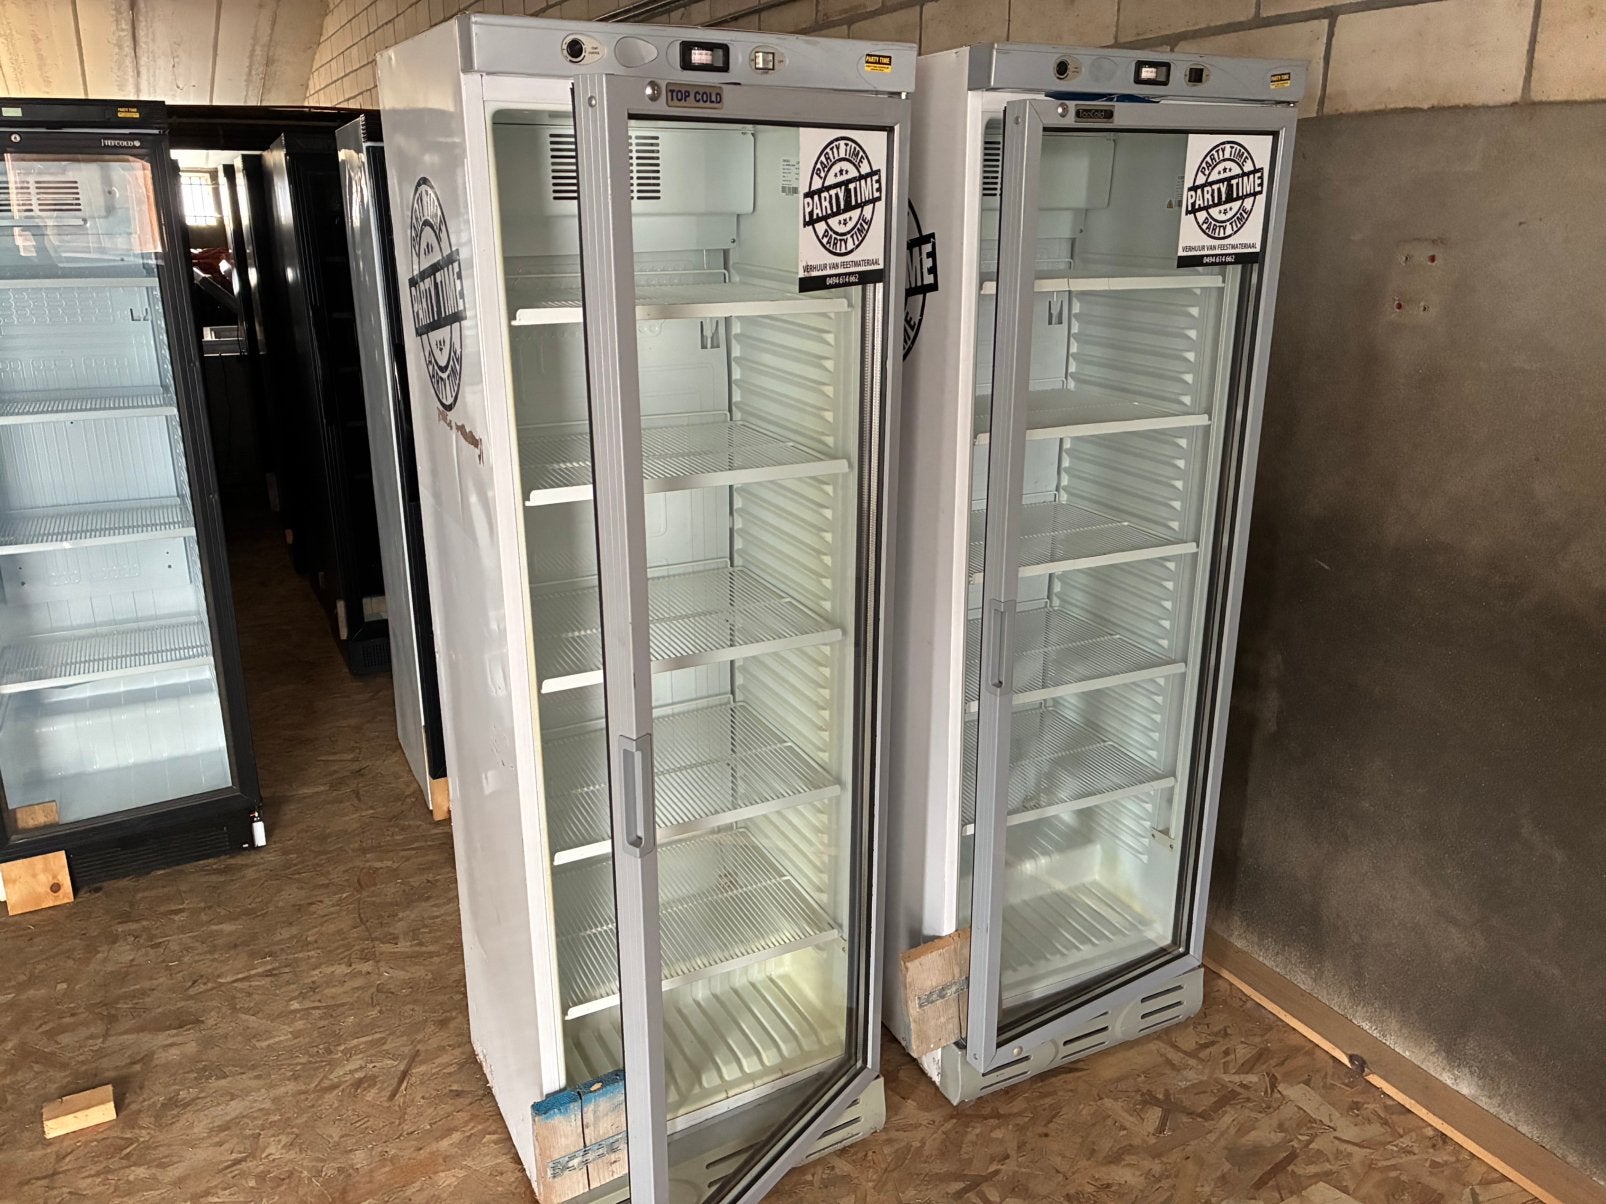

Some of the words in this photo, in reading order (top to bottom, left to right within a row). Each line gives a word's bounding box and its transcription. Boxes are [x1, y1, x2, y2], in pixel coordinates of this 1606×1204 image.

[866, 55, 879, 63] PARTY
[669, 89, 691, 101] TOP
[694, 90, 722, 104] COLD
[815, 142, 840, 180] PARTY
[844, 142, 865, 169] TIME
[1200, 146, 1226, 177] PARTY
[1229, 145, 1249, 167] TIME
[804, 185, 845, 222] PARTY
[849, 174, 880, 206] TIME
[1187, 181, 1228, 211] PARTY
[1231, 172, 1262, 198] TIME
[821, 228, 849, 251] PARTY
[852, 214, 870, 246] TIME
[1201, 216, 1227, 236] PARTY
[1229, 205, 1249, 235] TIME
[1182, 244, 1205, 252] VERHUUR
[1217, 242, 1257, 251] FEESTMATERIAAL
[803, 262, 828, 273] VERHUUR
[828, 261, 839, 270] VAN
[840, 258, 880, 269] FEESTMATERIAAL
[826, 276, 839, 285] 0494
[840, 275, 849, 283] 614
[850, 274, 859, 282] 662
[906, 241, 935, 290] ME
[411, 274, 437, 328] PARTY
[436, 261, 464, 317] TIME
[427, 349, 448, 401] PARTY
